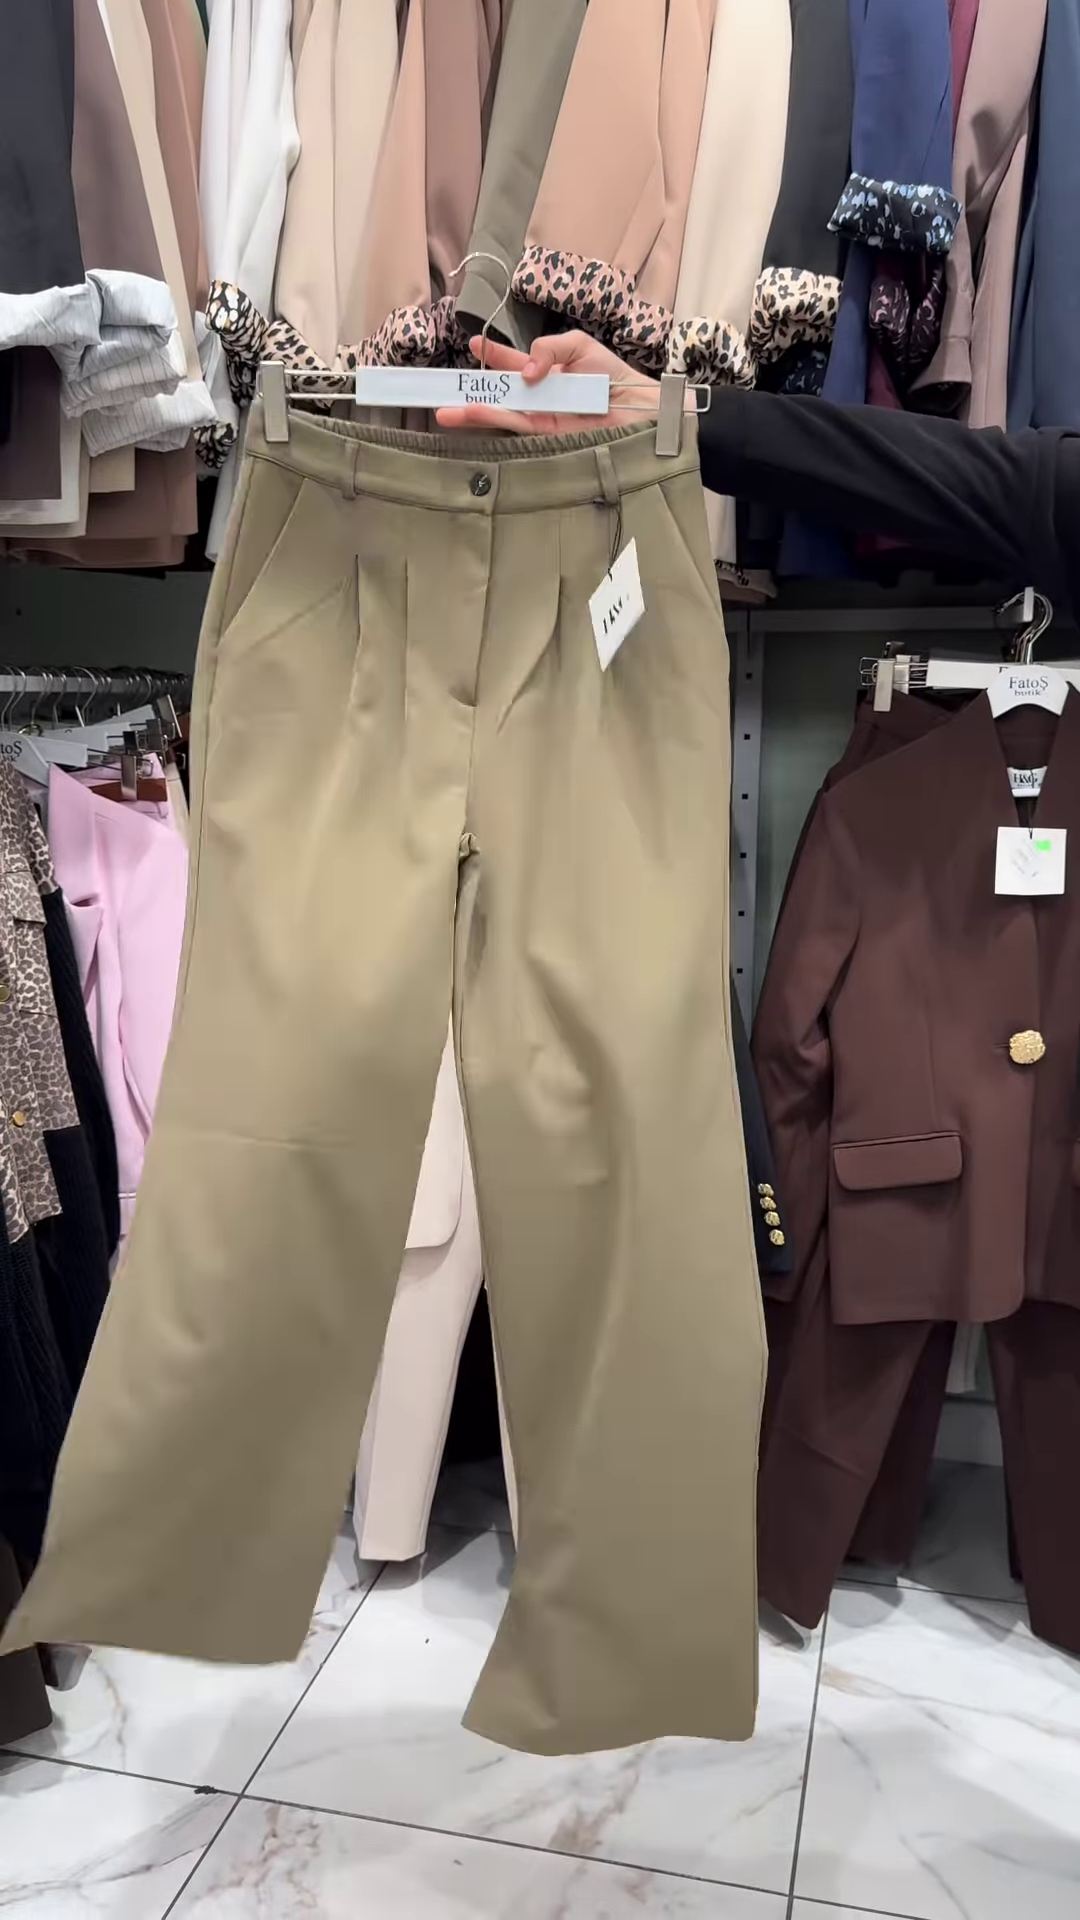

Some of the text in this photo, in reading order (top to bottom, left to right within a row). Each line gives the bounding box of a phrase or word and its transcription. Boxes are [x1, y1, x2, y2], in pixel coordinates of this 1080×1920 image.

[458, 373, 511, 397] FatoŞ
[465, 393, 502, 404] butik
[1009, 676, 1049, 691] FatoŞ
